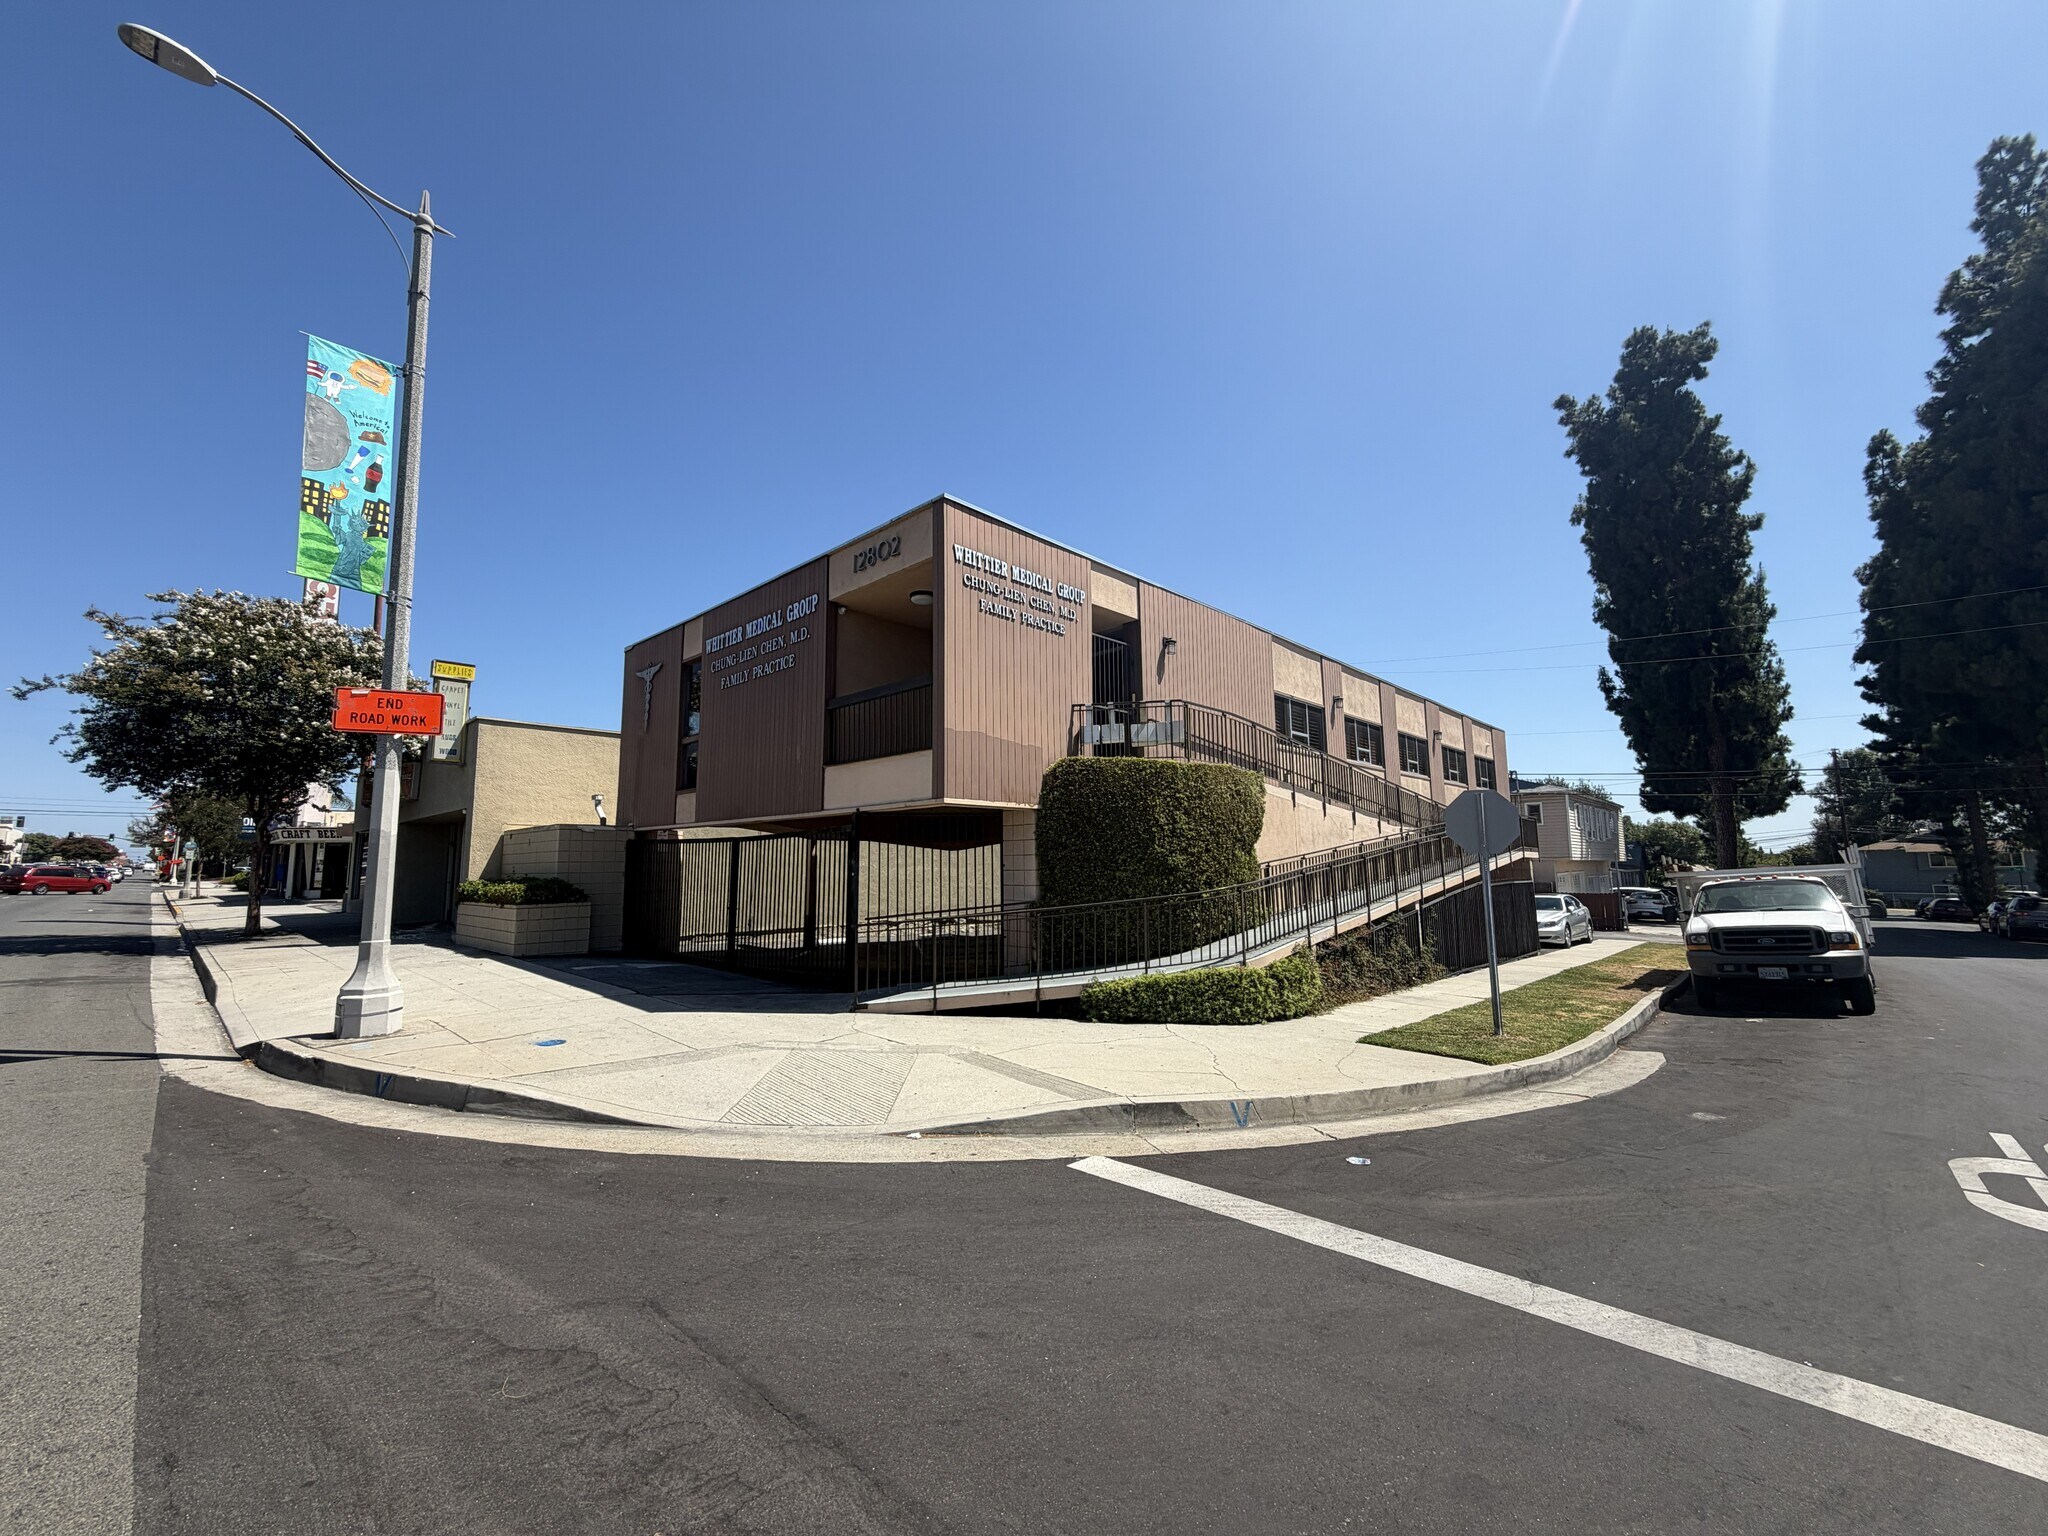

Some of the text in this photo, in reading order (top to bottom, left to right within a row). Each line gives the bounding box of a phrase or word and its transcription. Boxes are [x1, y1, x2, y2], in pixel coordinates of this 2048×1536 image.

[349, 410, 383, 423] Welcome
[852, 535, 902, 574] 12802
[953, 543, 1086, 604] WHITTIER MEDICAL GROUP
[963, 573, 1027, 604] CHUNG-LIEN
[1030, 596, 1056, 616] CHEN,
[705, 593, 819, 655] WHITTIER MEDICAL GROUP
[980, 599, 1066, 636] FAMILY PRACTICE
[710, 627, 811, 673] CHUNG-LIEN CHEN, M.D.
[437, 664, 473, 677] SUPPLIES
[720, 653, 796, 690] FAMILY PRACTICE
[377, 697, 404, 710] END
[441, 685, 464, 694] CARPET
[350, 712, 427, 727] ROAD WORK
[281, 830, 311, 839] CRAFT
[318, 830, 343, 839] BEE
